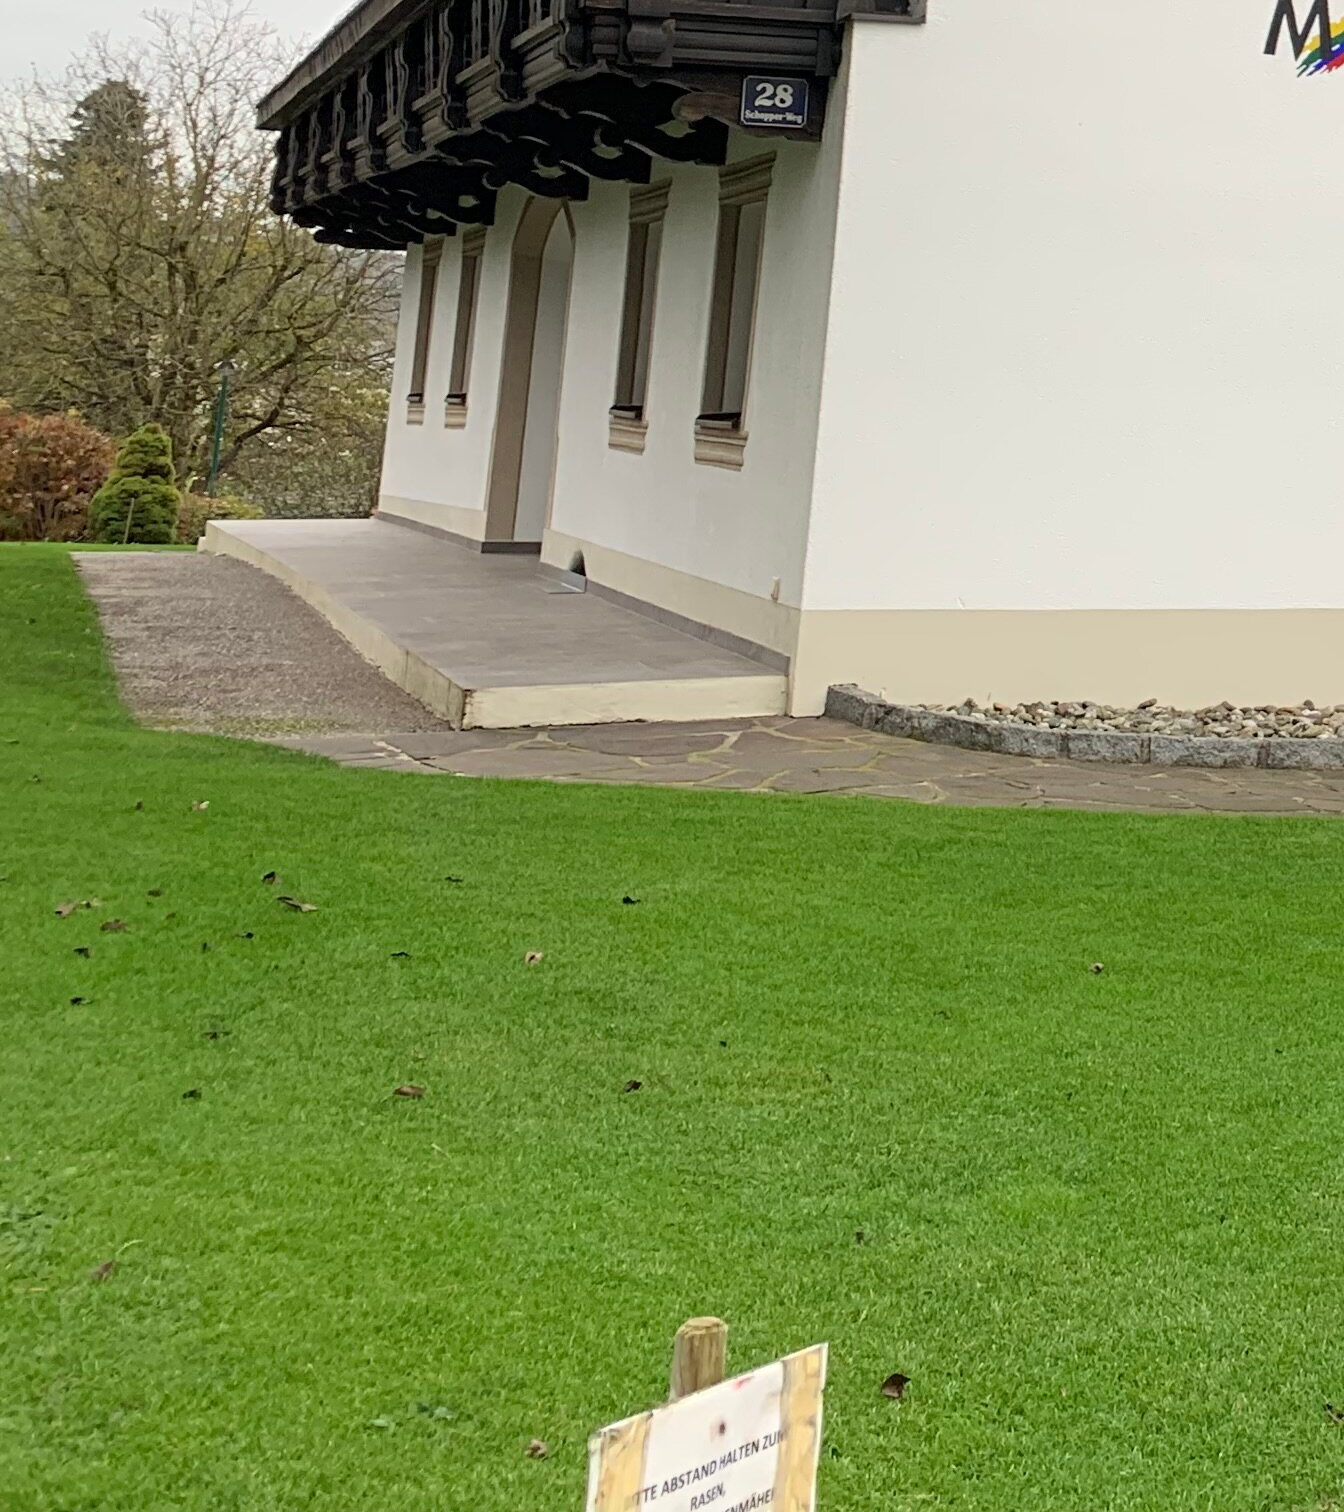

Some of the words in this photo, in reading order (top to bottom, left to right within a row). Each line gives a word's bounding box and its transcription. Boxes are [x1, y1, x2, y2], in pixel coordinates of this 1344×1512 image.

[754, 82, 794, 108] 28
[660, 1460, 718, 1497] ABSTAND
[718, 1439, 760, 1470] HALTEN
